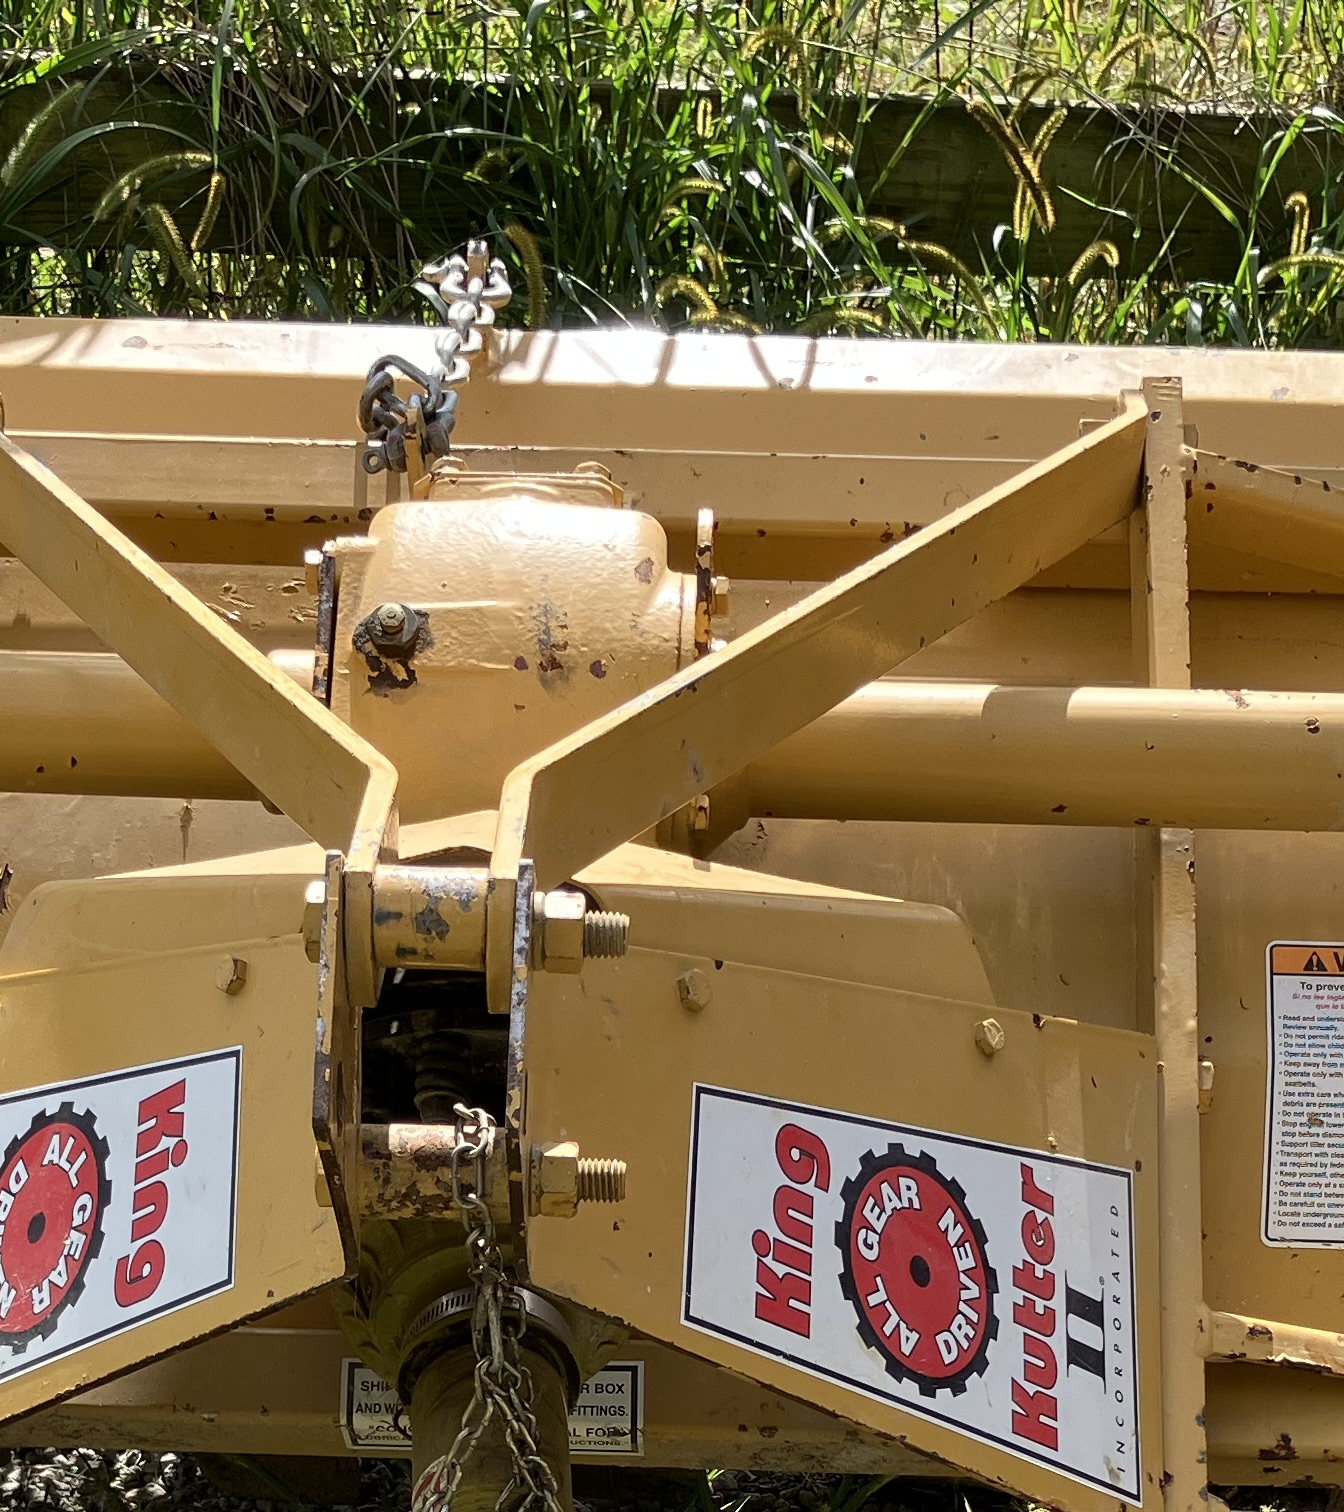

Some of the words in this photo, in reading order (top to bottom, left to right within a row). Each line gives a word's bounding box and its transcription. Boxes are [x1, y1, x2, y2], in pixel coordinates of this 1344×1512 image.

[1300, 982, 1312, 990] To
[42, 1132, 88, 1189] ALL
[114, 1077, 188, 1308] King
[31, 1192, 93, 1315] GEAR
[751, 1122, 832, 1340] King
[857, 1176, 922, 1262] GEAR
[866, 1274, 921, 1357] ALL
[935, 1207, 980, 1366] DRIVEN
[1011, 1162, 1059, 1452] Kutter
[1110, 1204, 1125, 1473] INCORPORATED
[356, 1403, 381, 1413] AND
[595, 1383, 625, 1394] BOX
